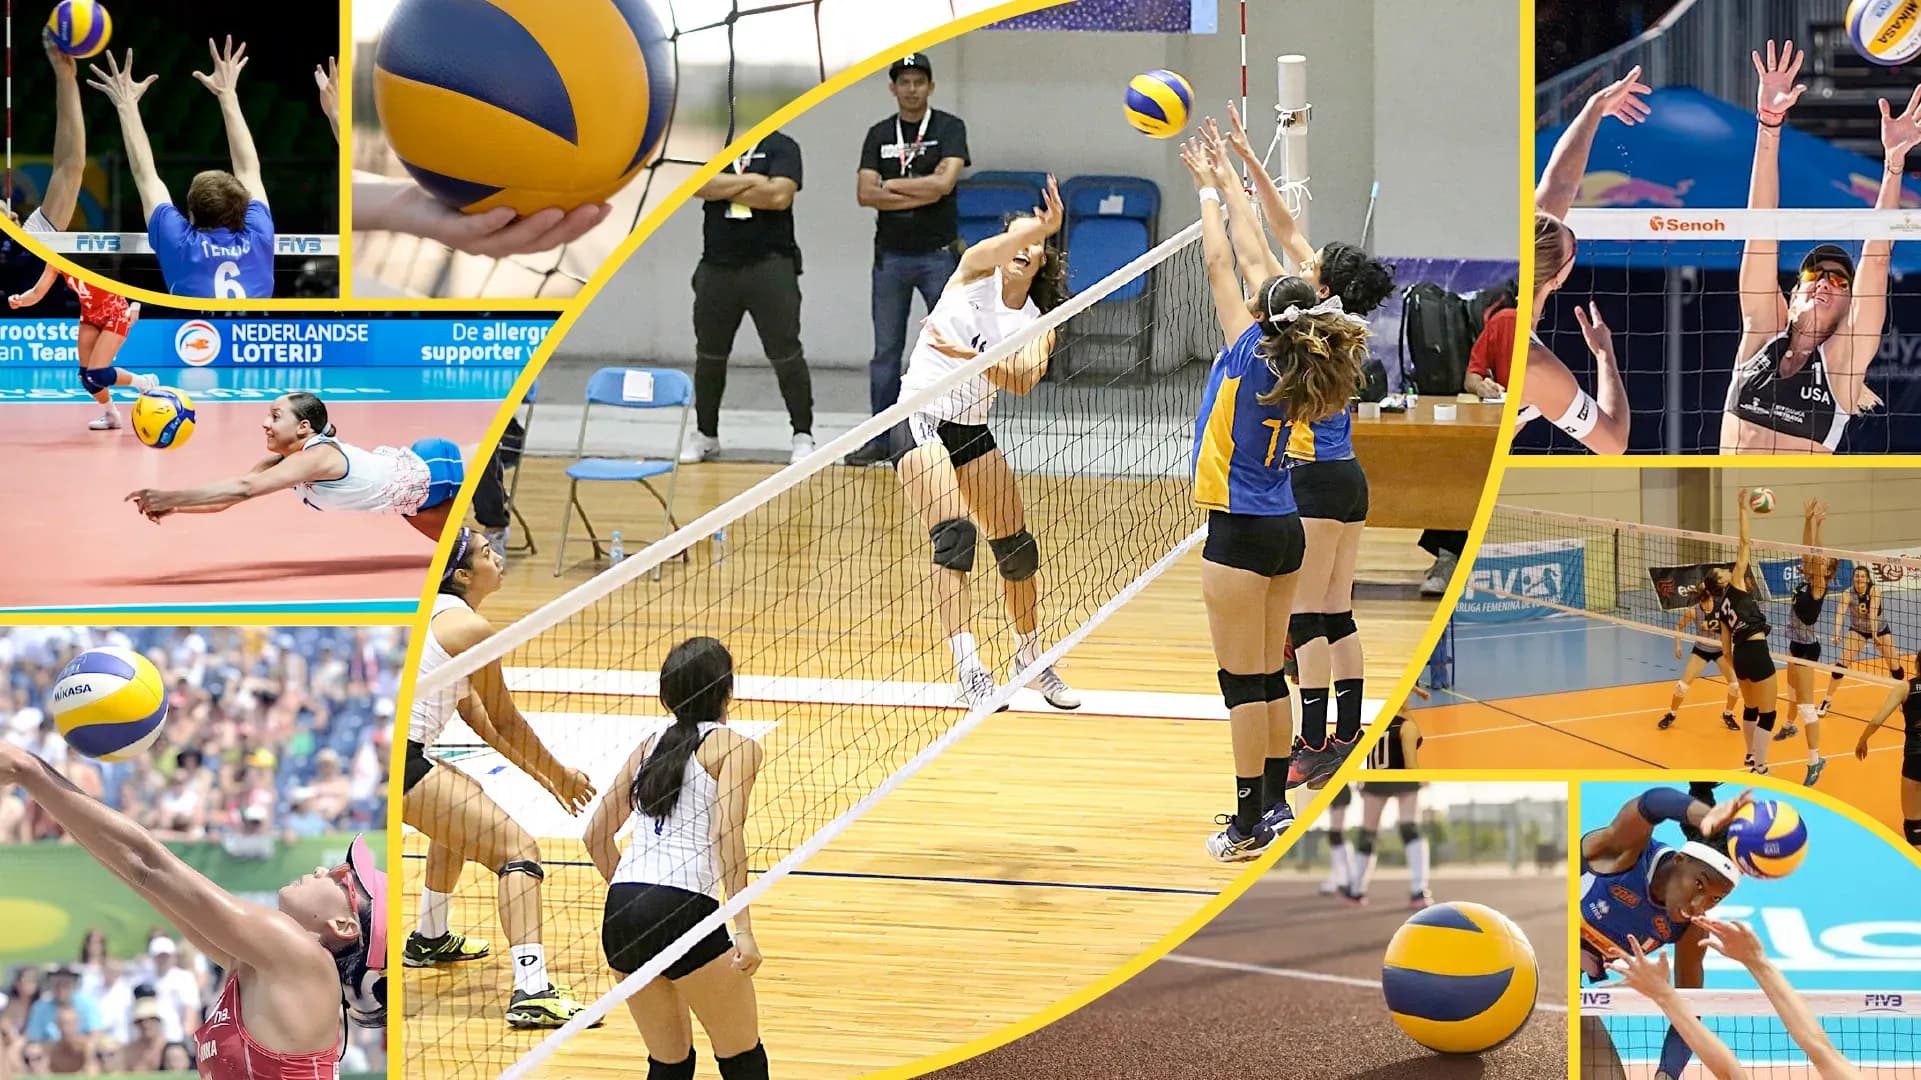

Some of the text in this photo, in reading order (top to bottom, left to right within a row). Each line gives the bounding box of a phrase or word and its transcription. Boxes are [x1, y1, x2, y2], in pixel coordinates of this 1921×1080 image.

[1666, 218, 1726, 232] Senoh
[76, 235, 121, 252] FIVB
[278, 236, 323, 253] FIVB
[214, 260, 247, 299] 6
[231, 323, 369, 342] NEDERLANDSE
[452, 322, 552, 346] De allergr
[231, 343, 323, 363] LOTERIJ
[420, 343, 522, 365] supporter
[1811, 361, 1822, 385] 1
[1800, 386, 1831, 406] USA
[1865, 993, 1903, 1007] FIVB
